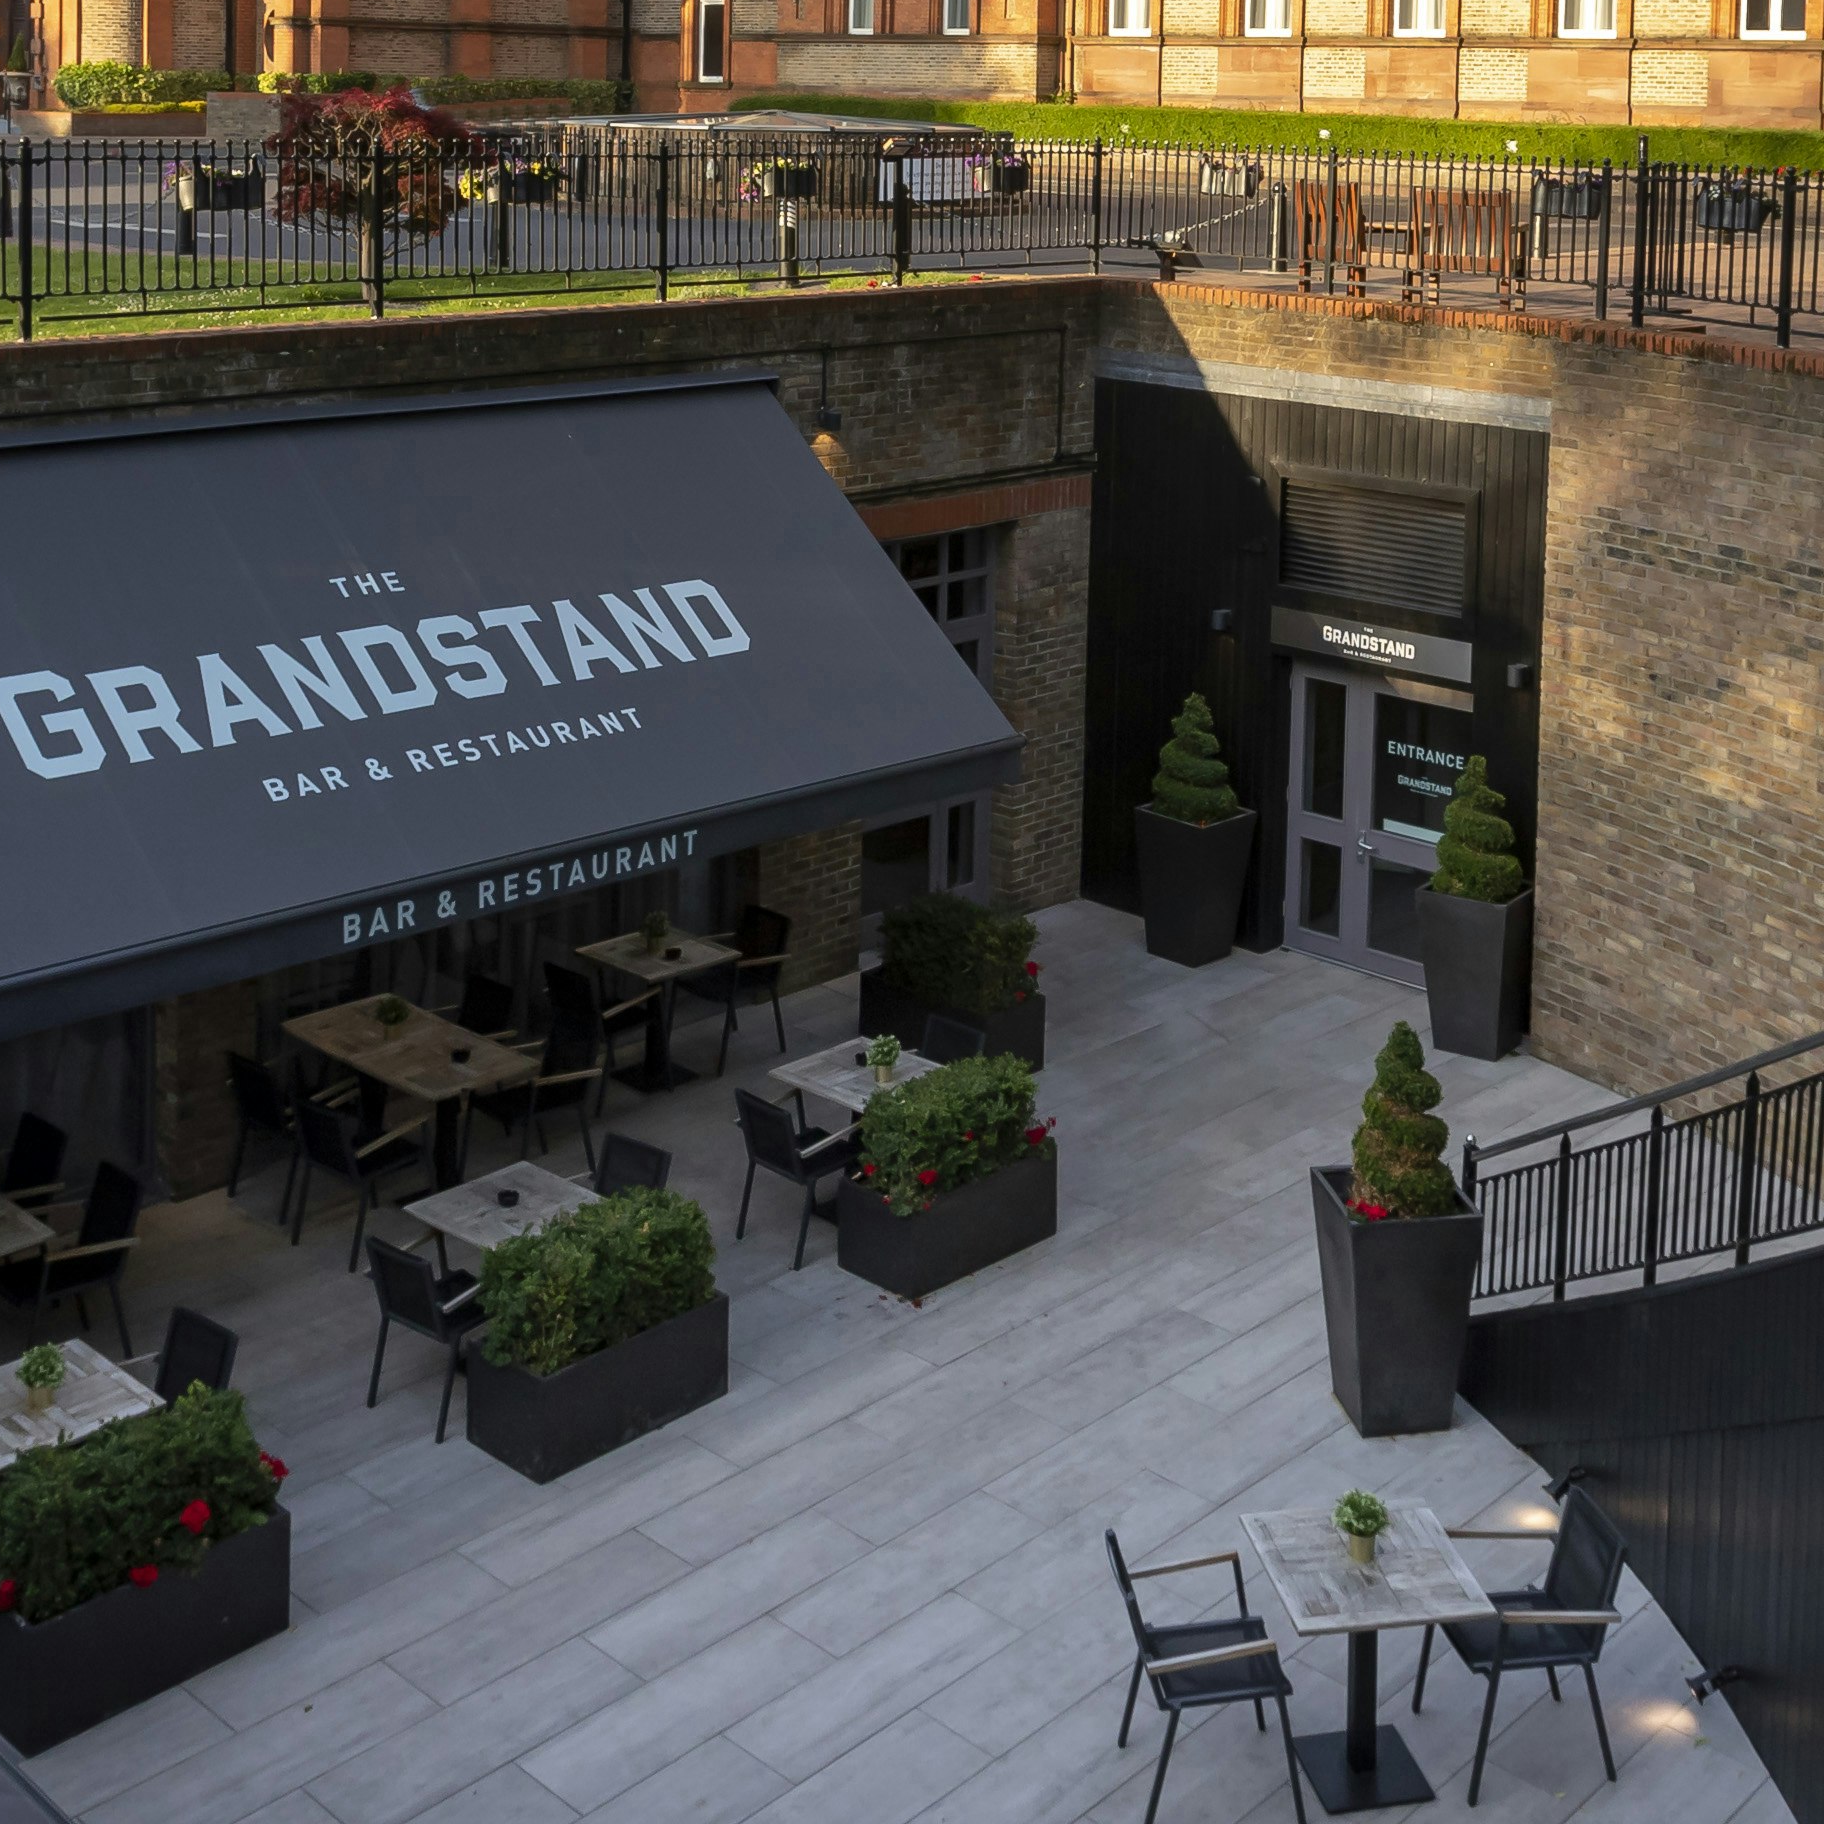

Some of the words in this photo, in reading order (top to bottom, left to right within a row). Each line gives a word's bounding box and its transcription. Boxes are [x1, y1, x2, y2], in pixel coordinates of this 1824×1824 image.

[328, 571, 406, 598] THE
[1322, 625, 1416, 660] GRANDSTAND
[262, 766, 350, 802] BAR
[364, 757, 394, 781] &
[405, 707, 642, 773] RESTAURANT
[1387, 740, 1465, 770] ENTRANCE
[343, 900, 416, 944] BAR
[437, 890, 457, 919] &
[479, 829, 698, 909] RESTAURANT
